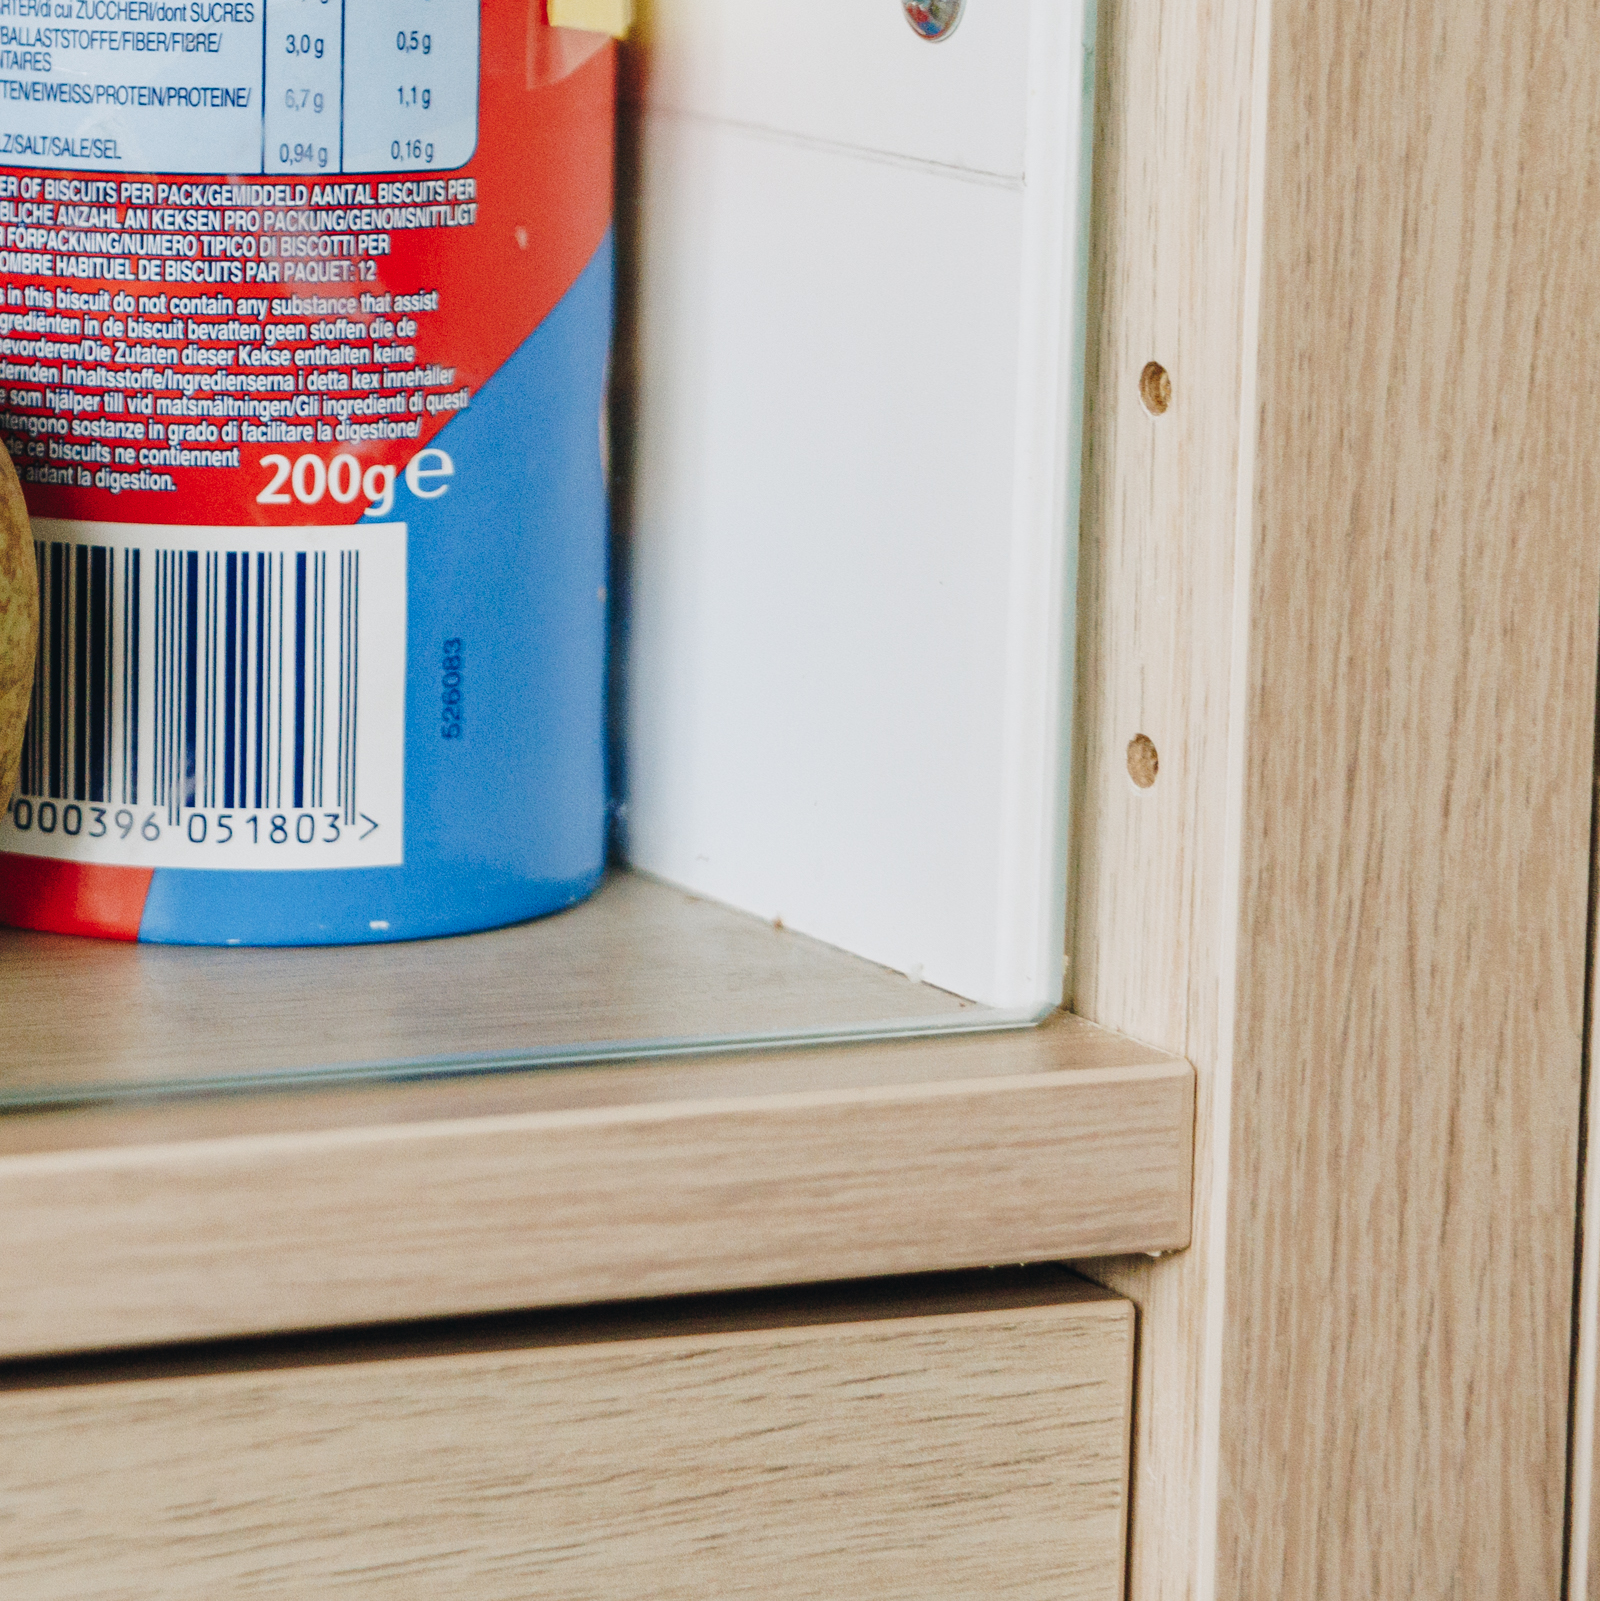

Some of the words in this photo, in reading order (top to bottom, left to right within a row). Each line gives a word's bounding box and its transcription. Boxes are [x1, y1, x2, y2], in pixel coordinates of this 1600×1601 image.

[76, 0, 187, 22] ZUCCHERI/dont
[190, 3, 255, 23] SUCRES
[279, 144, 314, 166] 0,94
[391, 140, 422, 162] 0,16
[44, 178, 117, 203] BISCUITS
[120, 182, 154, 205] PER
[157, 184, 308, 207] PACK/GEMIDDELD
[310, 184, 376, 206] AANTAL
[378, 180, 445, 204] BISCUITS
[448, 178, 476, 201] PER
[56, 204, 121, 229] ANZAHL
[124, 207, 148, 230] AN
[151, 209, 221, 232] KEKSEN
[224, 210, 259, 232] PRO
[263, 203, 477, 232] PACKUNG/GENOMSNITTLIGT
[7, 223, 197, 257] FÖRPACKNING/NUMERO
[200, 235, 256, 258] TIPICO
[280, 235, 355, 258] BISCOTTI
[358, 233, 391, 256] PER
[55, 255, 135, 281] HABITUEL
[138, 259, 162, 282] DE
[164, 260, 243, 283] BISCUITS
[245, 260, 280, 283] PAR
[283, 260, 356, 283] PAQUET:
[56, 287, 111, 312] biscuit
[138, 293, 167, 314] not
[169, 293, 234, 316] contain
[236, 296, 268, 321] any
[271, 293, 357, 316] substance
[360, 291, 392, 314] that
[393, 288, 439, 312] assist
[127, 317, 185, 340] biscuit
[187, 318, 261, 341] bevatten
[264, 323, 307, 346] geen
[310, 319, 367, 340] stoffen
[114, 341, 179, 364] Zutaten
[181, 343, 235, 366] dieser
[238, 344, 292, 366] Kekse
[294, 343, 370, 366] enthalten
[373, 342, 415, 364] keine
[62, 365, 295, 395] Inhaltsstoffe/Ingredienserna
[306, 370, 349, 392] detta
[352, 368, 382, 390] kex
[45, 388, 102, 415] hjälper
[156, 393, 320, 420] matsmältningen/Gli
[322, 393, 407, 420] ingredienti
[426, 388, 470, 415] questi
[71, 418, 145, 440] sostanze
[167, 422, 219, 447] grado
[240, 419, 315, 442] facilitare
[335, 417, 423, 444] digestione/
[48, 440, 111, 464] biscuits
[138, 446, 241, 467] contiennent
[256, 453, 397, 517] 200g
[95, 468, 178, 495] digestion.
[440, 637, 463, 740] 526083
[186, 812, 341, 845] 051803
